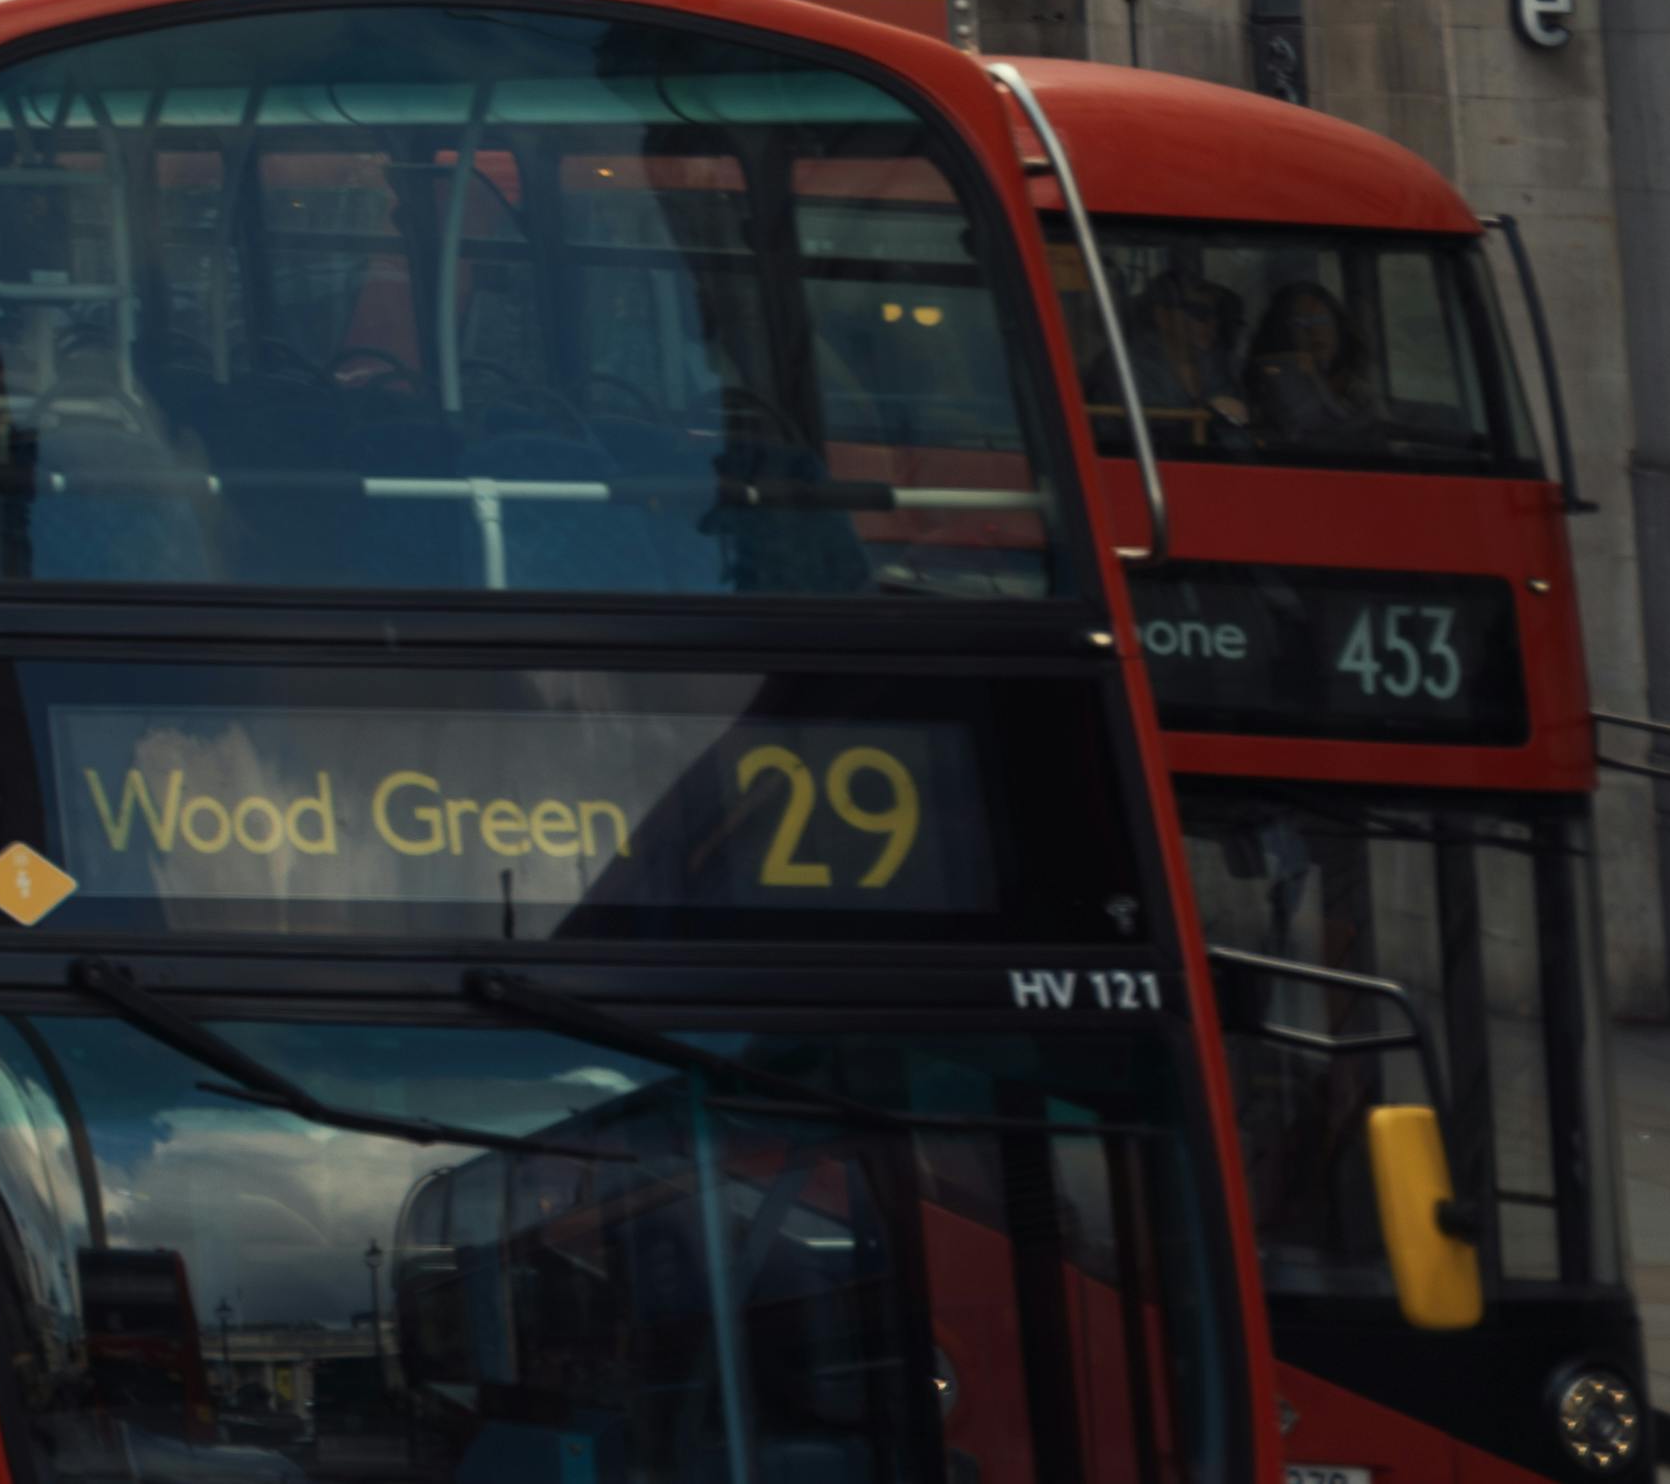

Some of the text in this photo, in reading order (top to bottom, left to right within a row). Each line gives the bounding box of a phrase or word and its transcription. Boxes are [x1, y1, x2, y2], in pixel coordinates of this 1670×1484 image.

[1140, 606, 1463, 700] one 453
[82, 743, 920, 889] Wood Green 29
[1010, 972, 1162, 1011] HV 121
